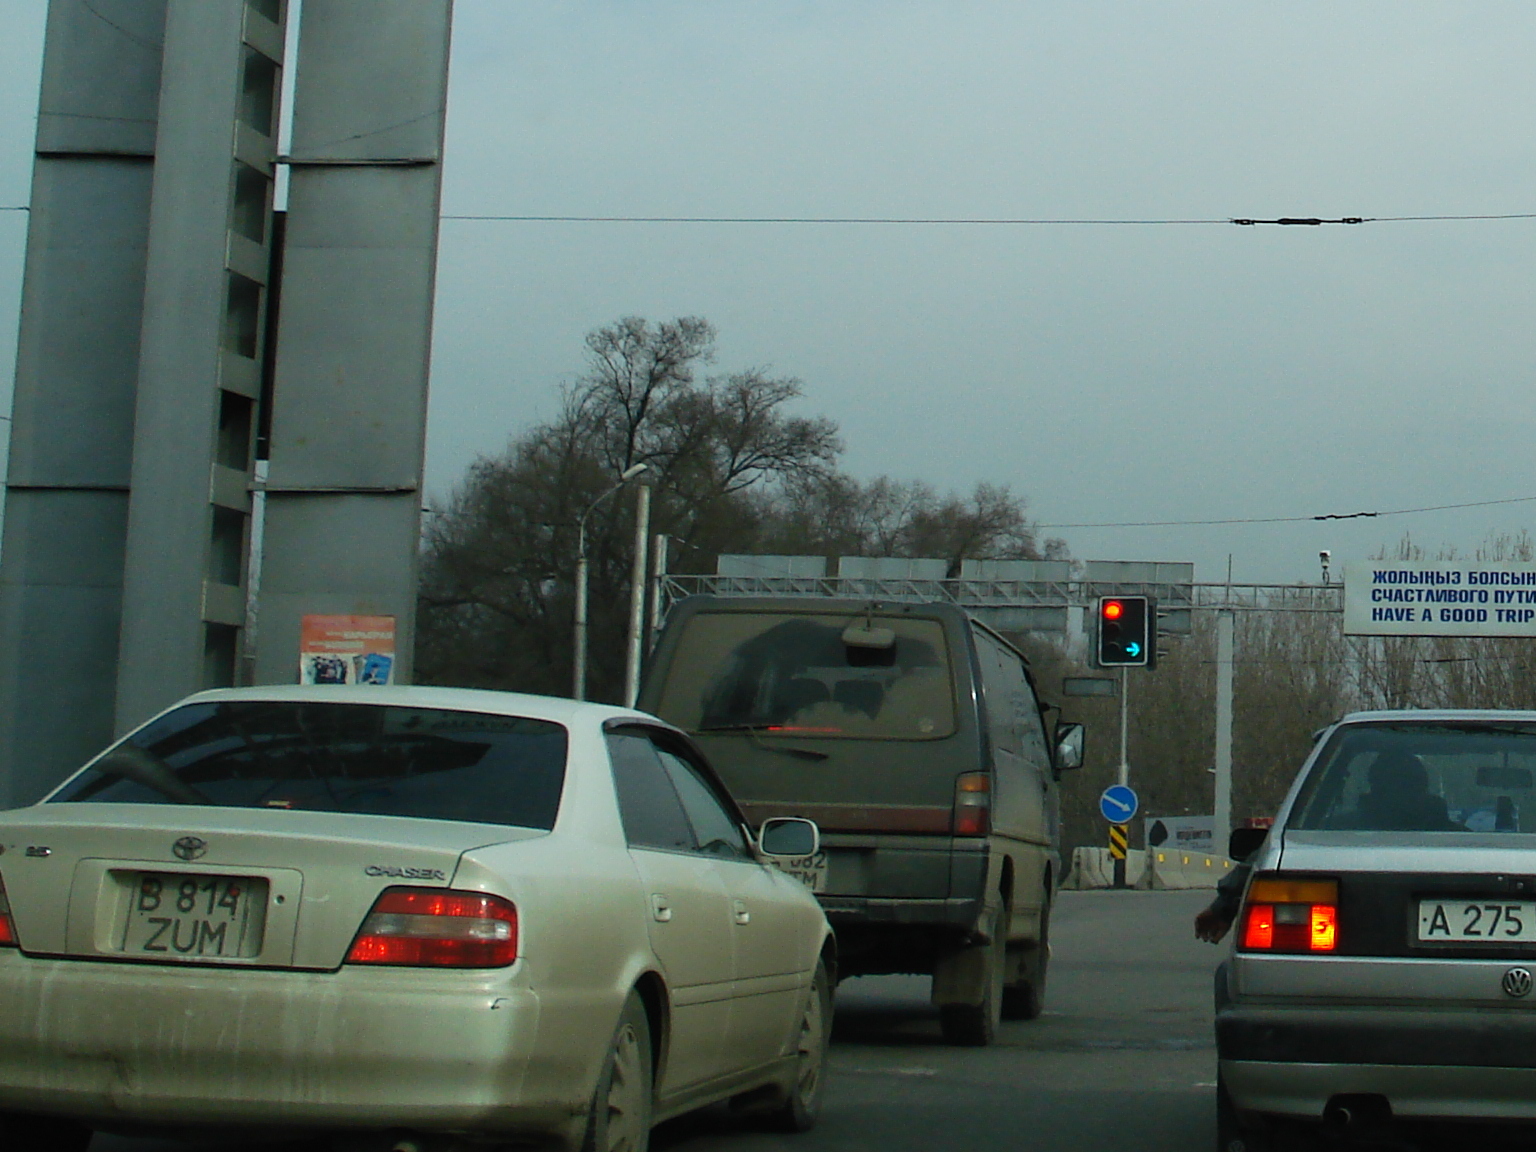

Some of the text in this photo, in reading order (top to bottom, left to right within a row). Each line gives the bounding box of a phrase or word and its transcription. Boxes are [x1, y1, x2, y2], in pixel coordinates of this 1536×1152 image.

[1373, 570, 1461, 587] ЖОЛЫҢЫЗ
[1468, 571, 1536, 586] БОЛСЫН
[1371, 588, 1489, 604] СЧАСТЛИВОГО
[1494, 589, 1536, 604] ПУТИ
[1371, 607, 1416, 622] HAVE
[1421, 608, 1433, 622] A
[1439, 609, 1488, 623] GOOD
[1494, 609, 1536, 624] TRIP
[365, 865, 446, 881] CHASER
[138, 878, 241, 916] B 814
[1428, 905, 1451, 936] A
[1463, 905, 1523, 937] 275
[143, 917, 227, 955] ZUM
